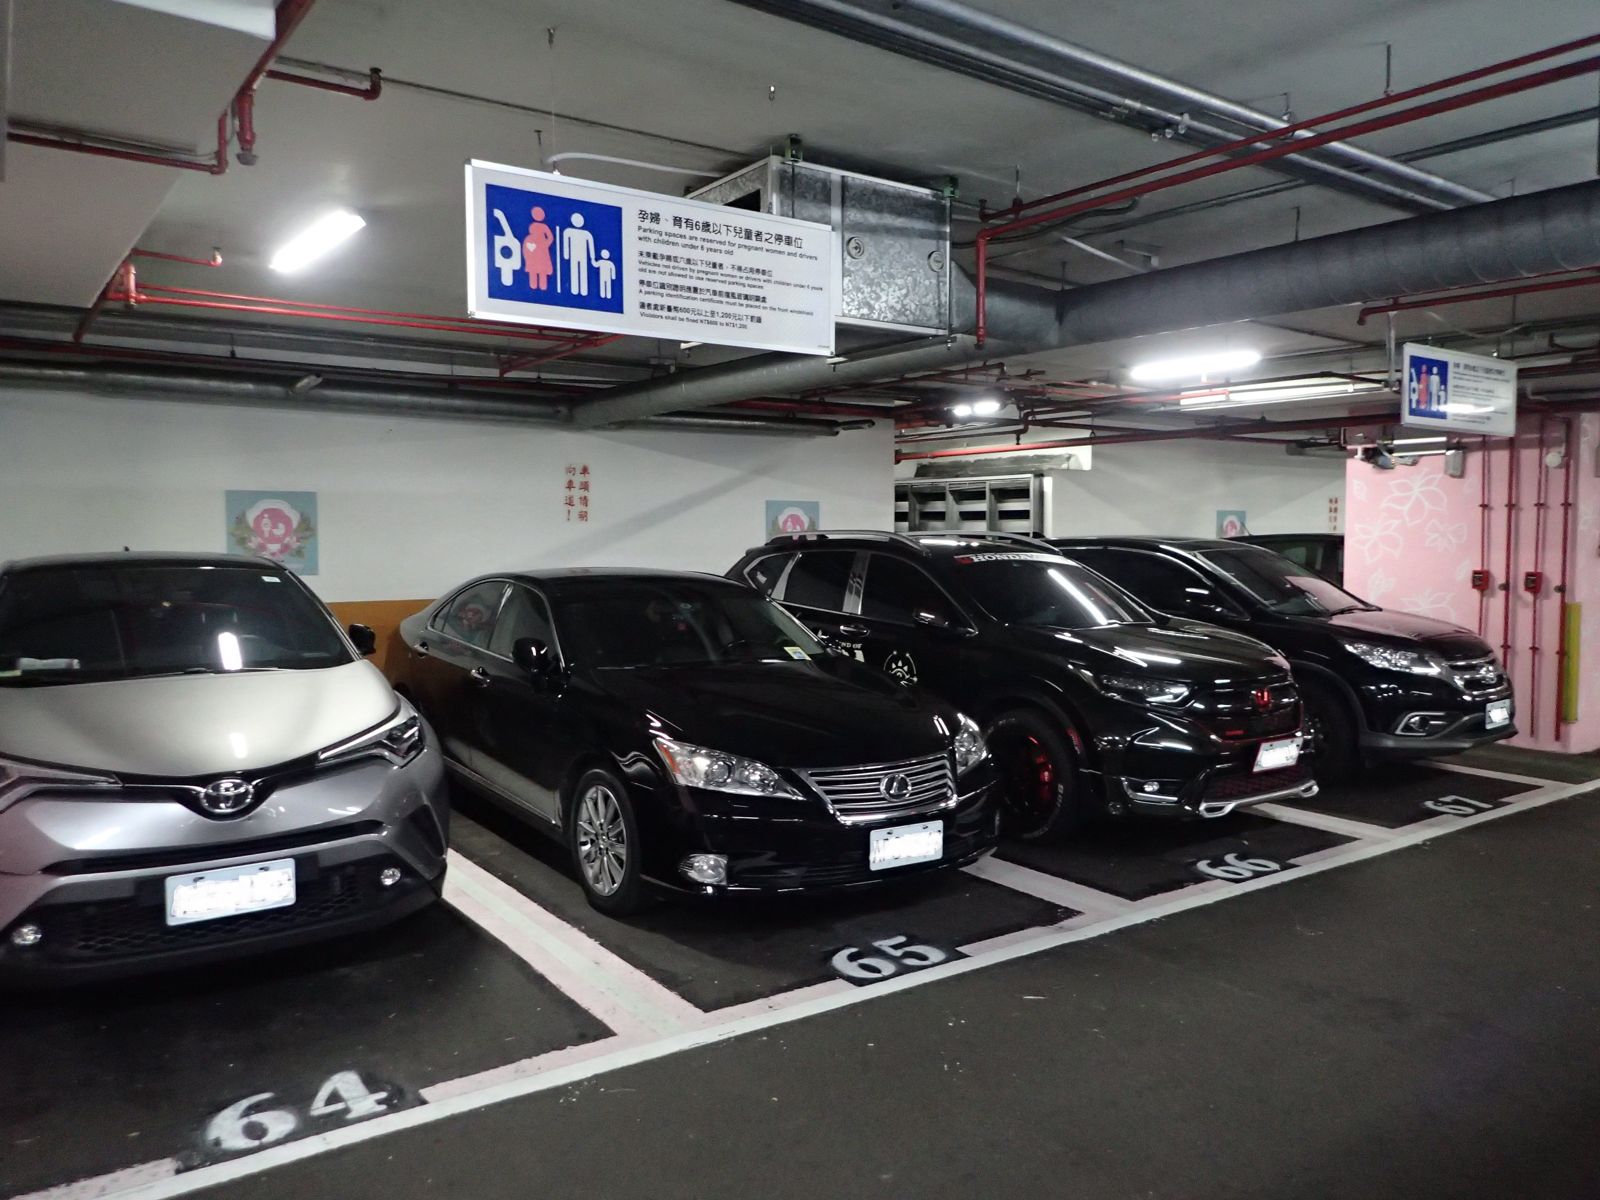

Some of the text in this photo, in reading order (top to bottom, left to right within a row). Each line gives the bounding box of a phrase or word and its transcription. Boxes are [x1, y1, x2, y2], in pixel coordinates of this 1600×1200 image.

[638, 226, 662, 236] Parking
[665, 231, 686, 240] spaces
[700, 237, 726, 246] reserved
[738, 243, 763, 251] pregnant
[654, 238, 679, 247] children
[706, 246, 722, 254] years
[1424, 795, 1493, 814] 67
[1196, 853, 1281, 879] 66
[831, 935, 946, 978] 65
[206, 1070, 388, 1150] 64
